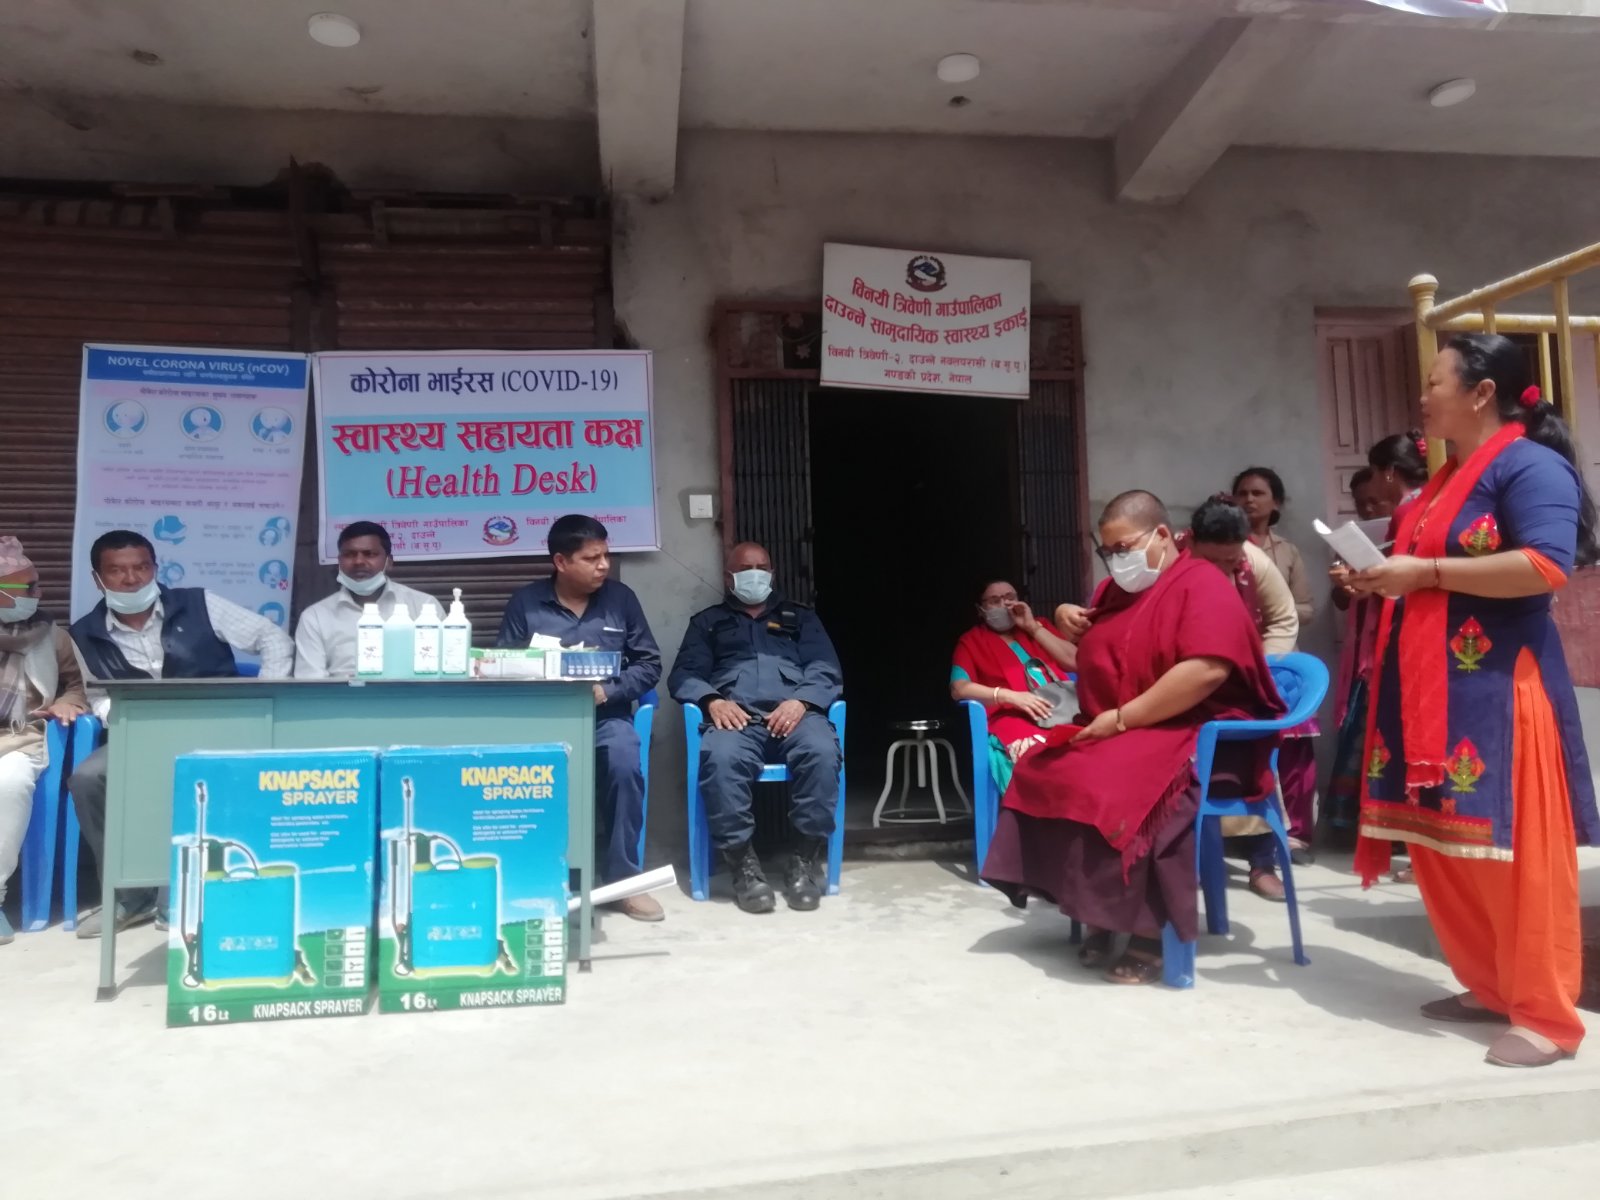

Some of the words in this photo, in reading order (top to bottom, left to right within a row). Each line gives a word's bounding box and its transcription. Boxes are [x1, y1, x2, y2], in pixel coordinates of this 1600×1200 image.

[852, 276, 889, 309] विनयी
[893, 292, 931, 317] त्रिवेणी
[824, 294, 866, 328] दाउन्ने
[870, 315, 939, 344] सामुदायिक
[944, 323, 990, 346] स्वास्थ्य
[994, 306, 1028, 338] इकाई
[108, 356, 149, 369] NOVEL
[152, 359, 206, 371] CORONA
[209, 361, 245, 373] VIRUS
[247, 363, 290, 377] (nCOV)
[350, 366, 420, 394] कोरोना
[428, 367, 494, 395] भाईरस
[502, 368, 619, 393] (COVID-19)
[948, 372, 973, 384] नेपाल
[331, 421, 446, 455] स्वास्थ्य
[457, 419, 574, 452] सहायता
[584, 419, 644, 449] कक्ष
[386, 463, 501, 499] (Health
[511, 462, 598, 494] Desk)
[259, 769, 360, 790] KNAPSACK
[461, 765, 554, 786] KNAPSACK
[282, 790, 359, 805] SPRAYER
[482, 785, 553, 800] SPRAYER
[460, 989, 515, 1007] KNAPSACK
[516, 987, 562, 1004] SPRAYER
[253, 1001, 311, 1019] KNAPSACK
[314, 998, 363, 1016] SPRAYER
